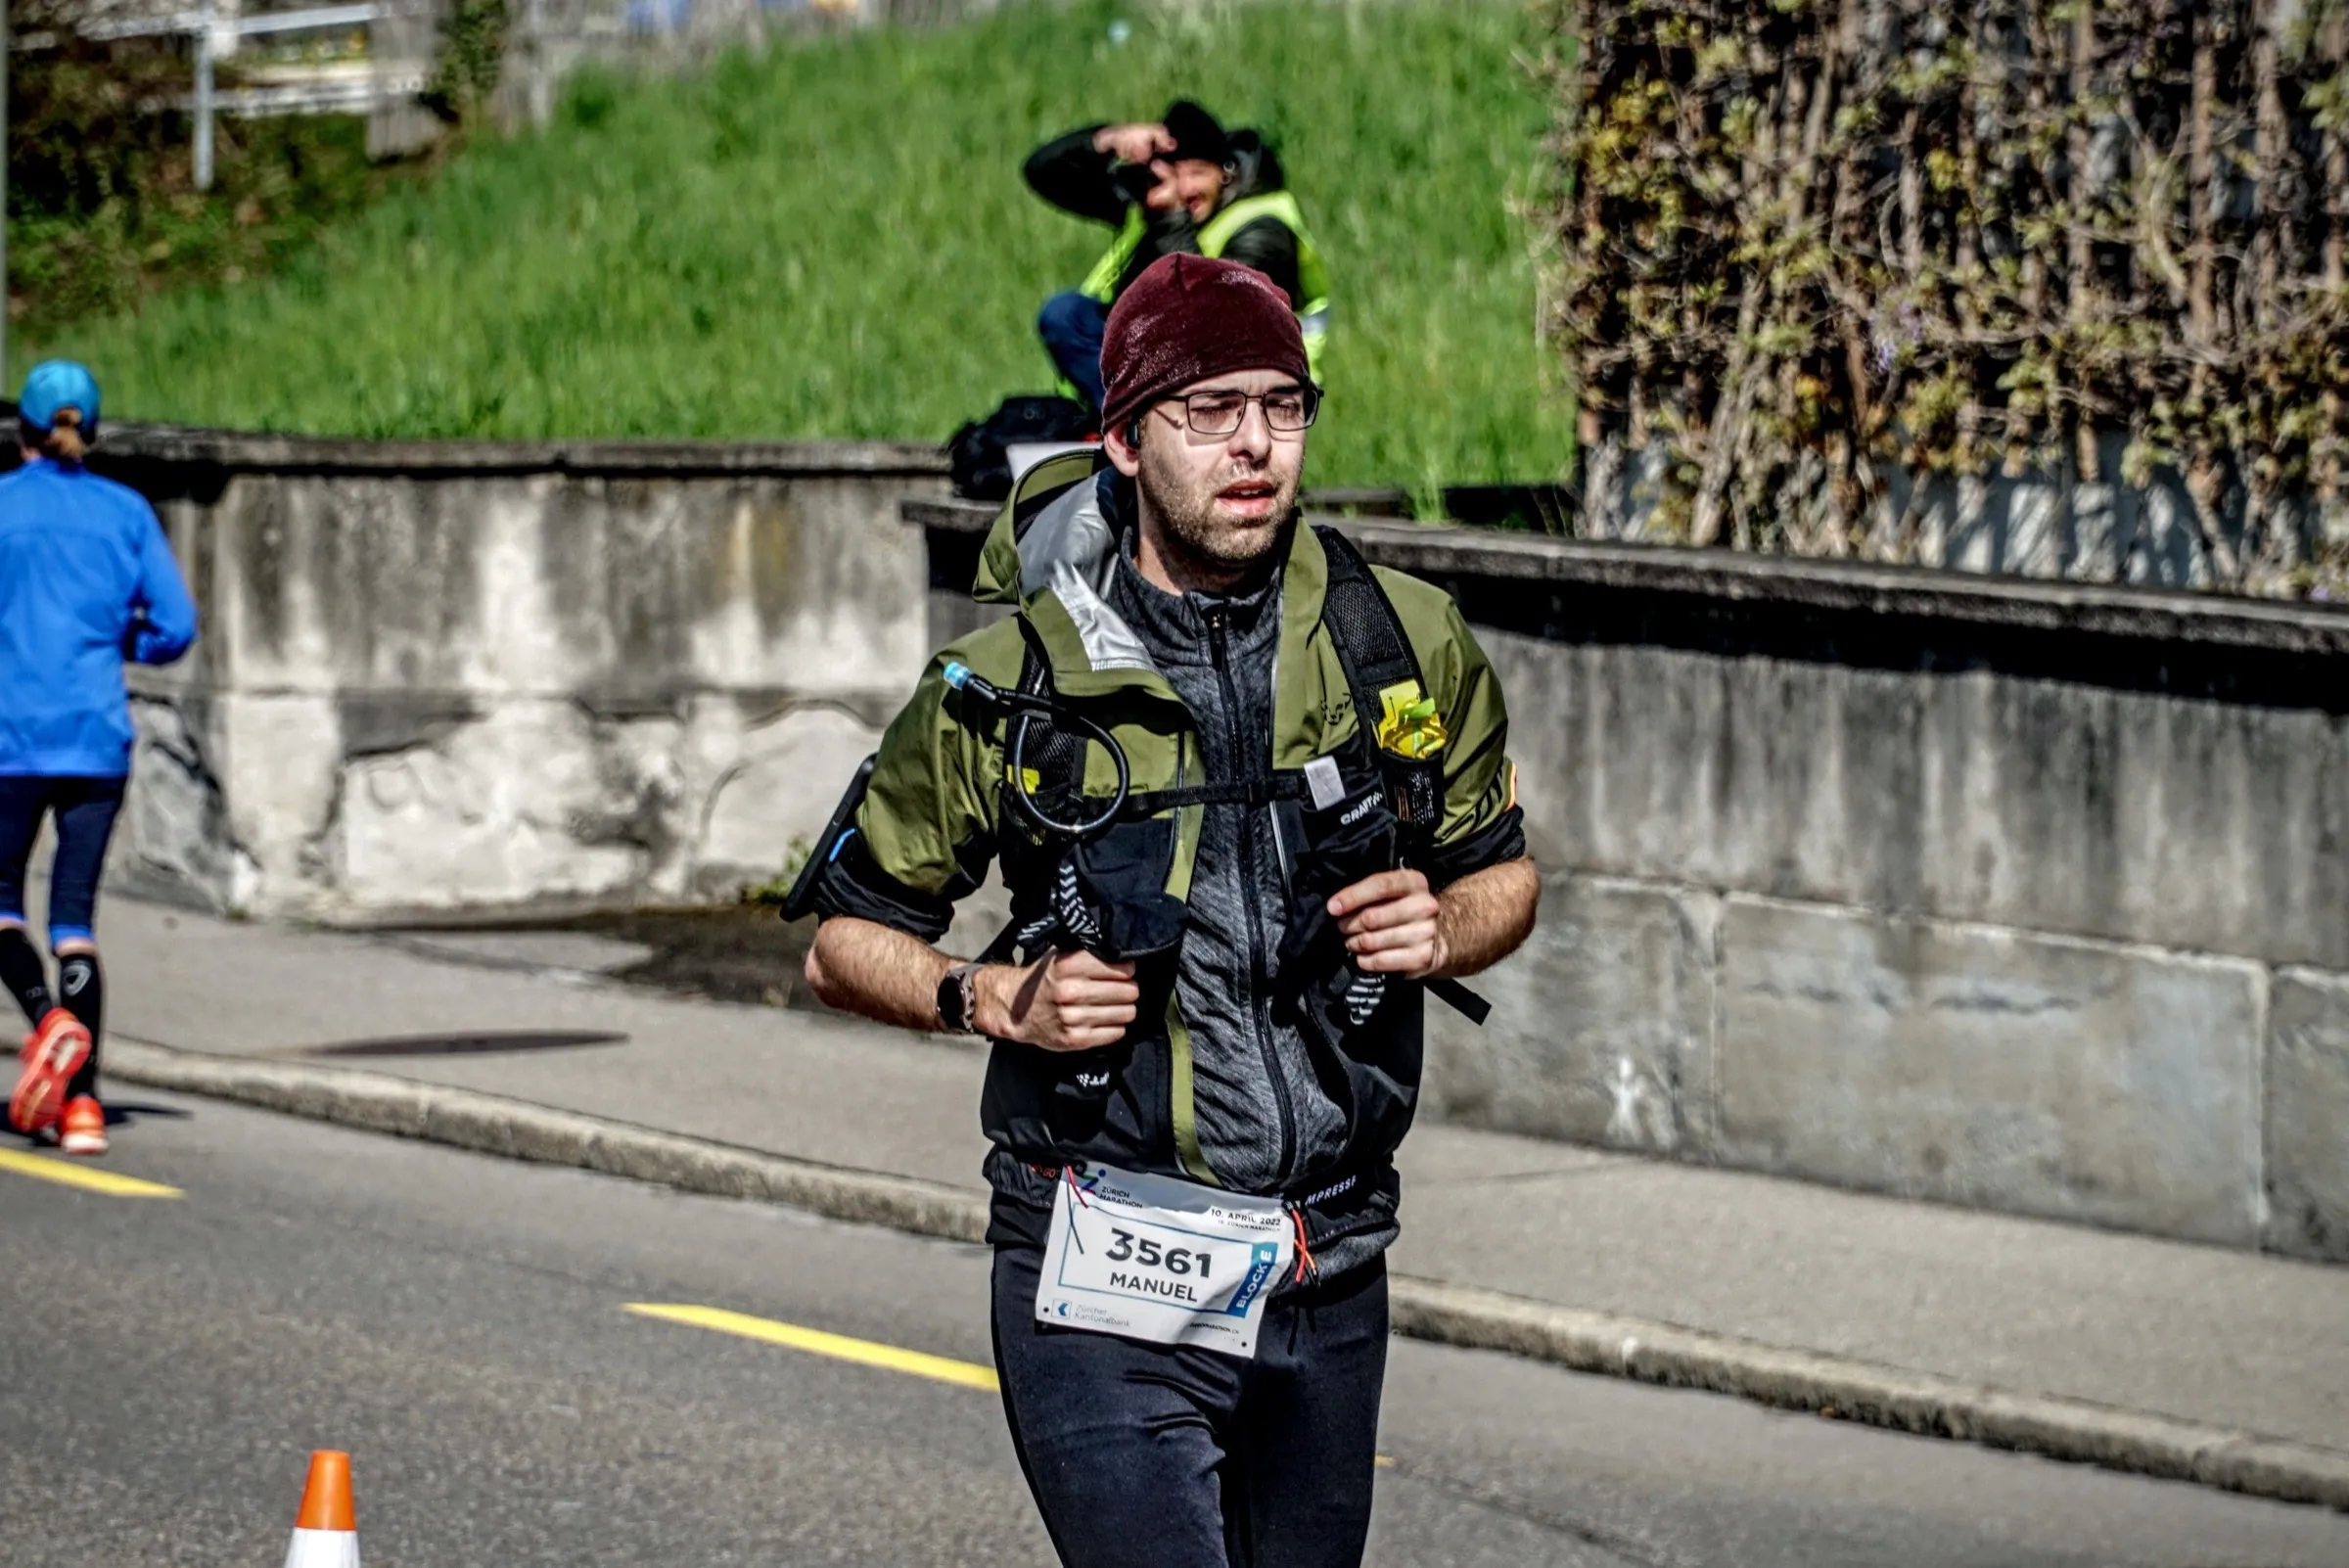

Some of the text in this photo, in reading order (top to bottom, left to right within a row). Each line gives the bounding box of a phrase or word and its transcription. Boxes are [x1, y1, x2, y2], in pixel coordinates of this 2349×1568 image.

[1340, 794, 1373, 826] CRAFT
[1098, 1192, 1143, 1210] MARATHON
[1101, 1185, 1130, 1199] ZÜRICH
[1211, 1208, 1223, 1219] 10.
[1227, 1211, 1257, 1223] APRIL
[1260, 1217, 1281, 1226] 2022
[1106, 1227, 1213, 1279] 3561
[1109, 1271, 1198, 1303] MANUEL
[1236, 1250, 1272, 1309] BLOCK E
[1075, 1304, 1109, 1316] Zürcher
[1074, 1313, 1131, 1329] Kantonalbank
